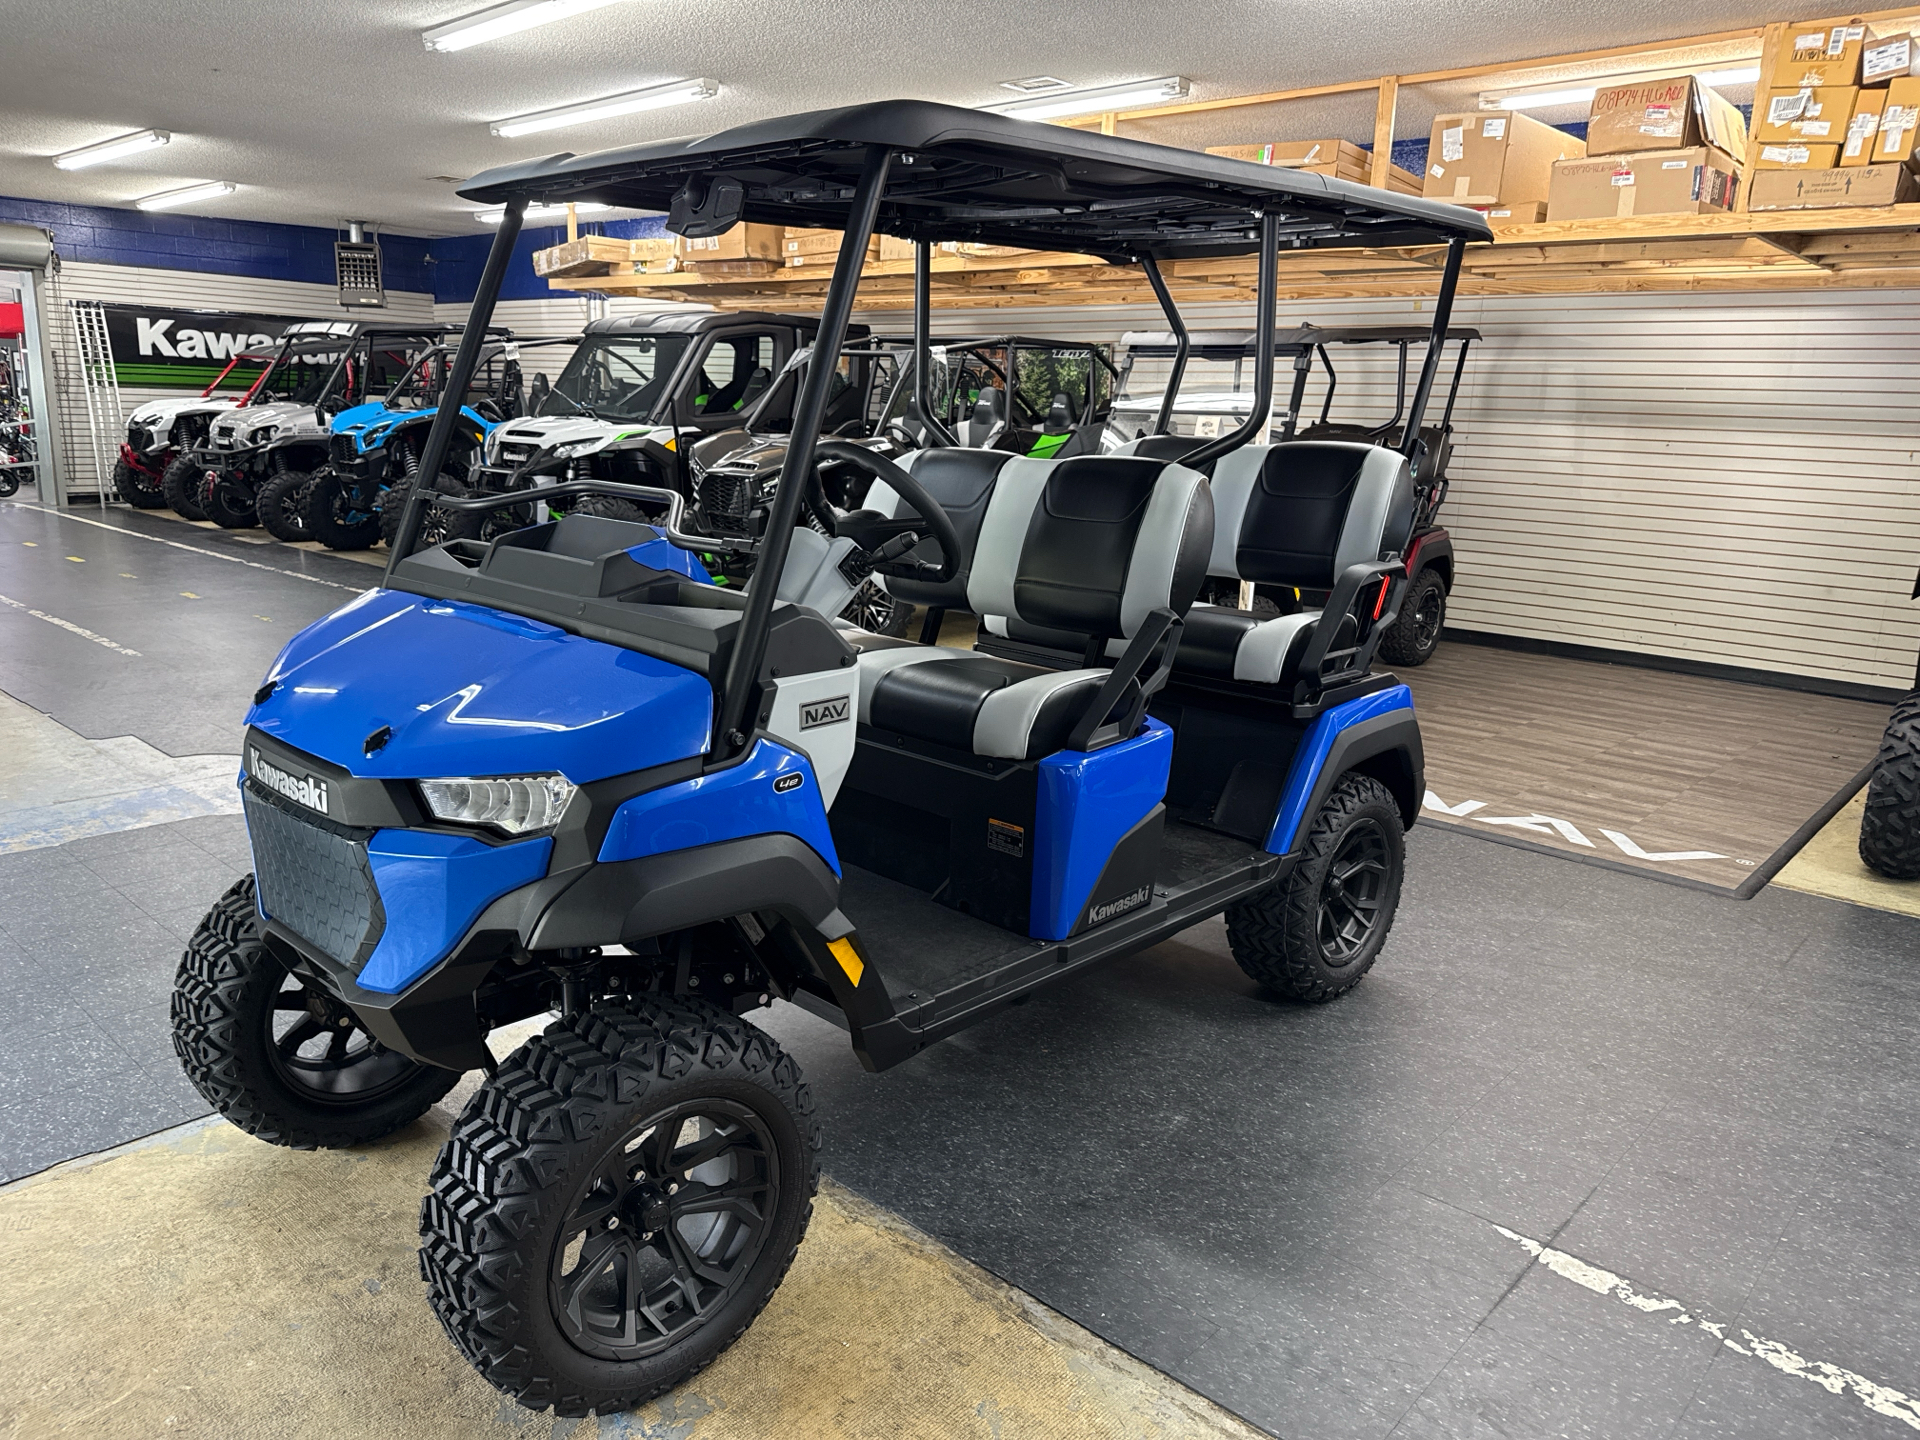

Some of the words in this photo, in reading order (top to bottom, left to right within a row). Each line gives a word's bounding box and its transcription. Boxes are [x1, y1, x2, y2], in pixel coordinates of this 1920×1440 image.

[503, 451, 528, 462] Kawasaki
[805, 702, 847, 724] NAV
[249, 744, 329, 815] Kawasaki
[1087, 885, 1150, 925] Kawasaki
